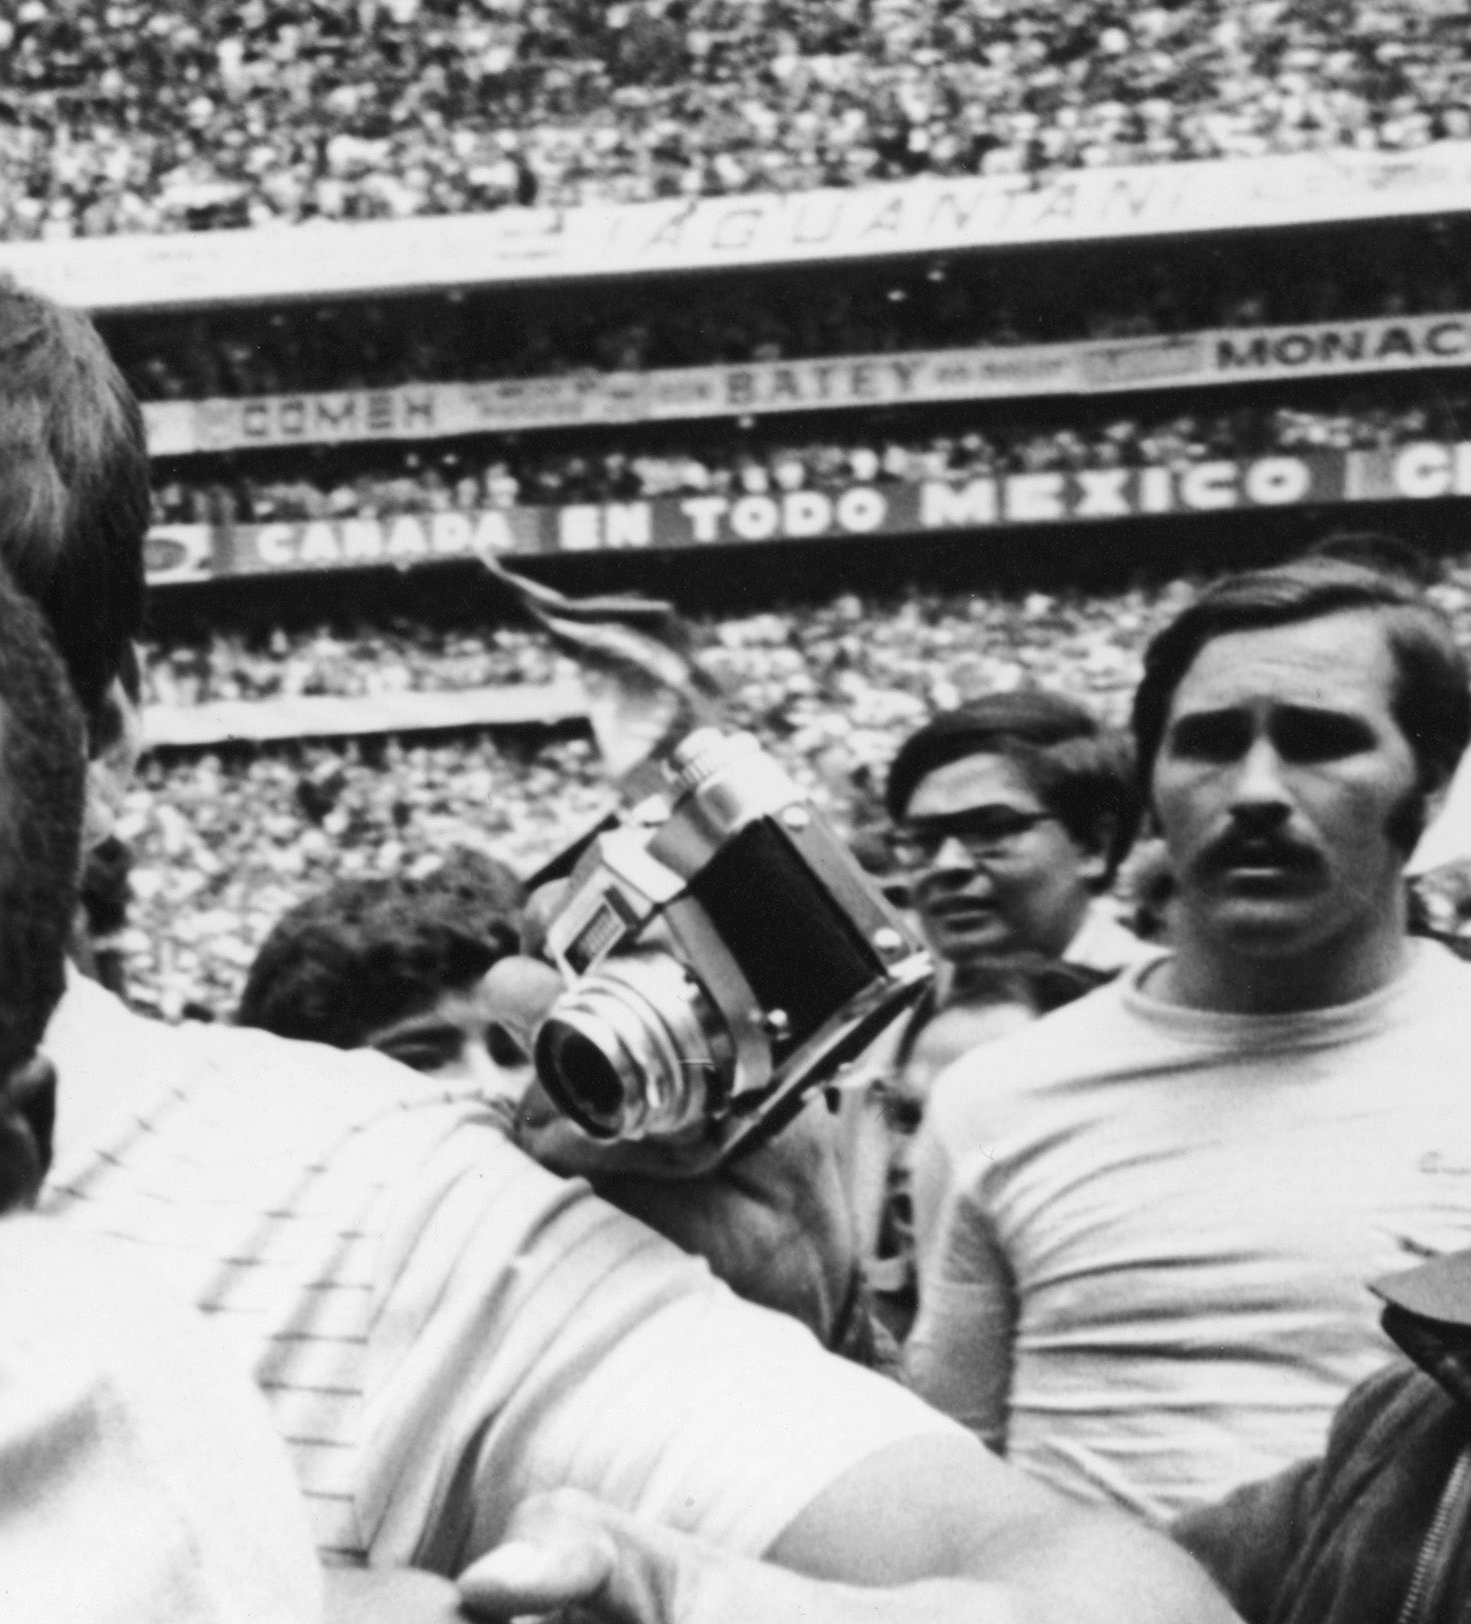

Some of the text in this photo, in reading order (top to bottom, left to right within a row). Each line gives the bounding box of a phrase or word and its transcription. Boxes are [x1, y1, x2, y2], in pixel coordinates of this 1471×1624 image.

[562, 501, 652, 551] EN
[683, 486, 887, 542] TODO
[920, 456, 1311, 527] MEXICO
